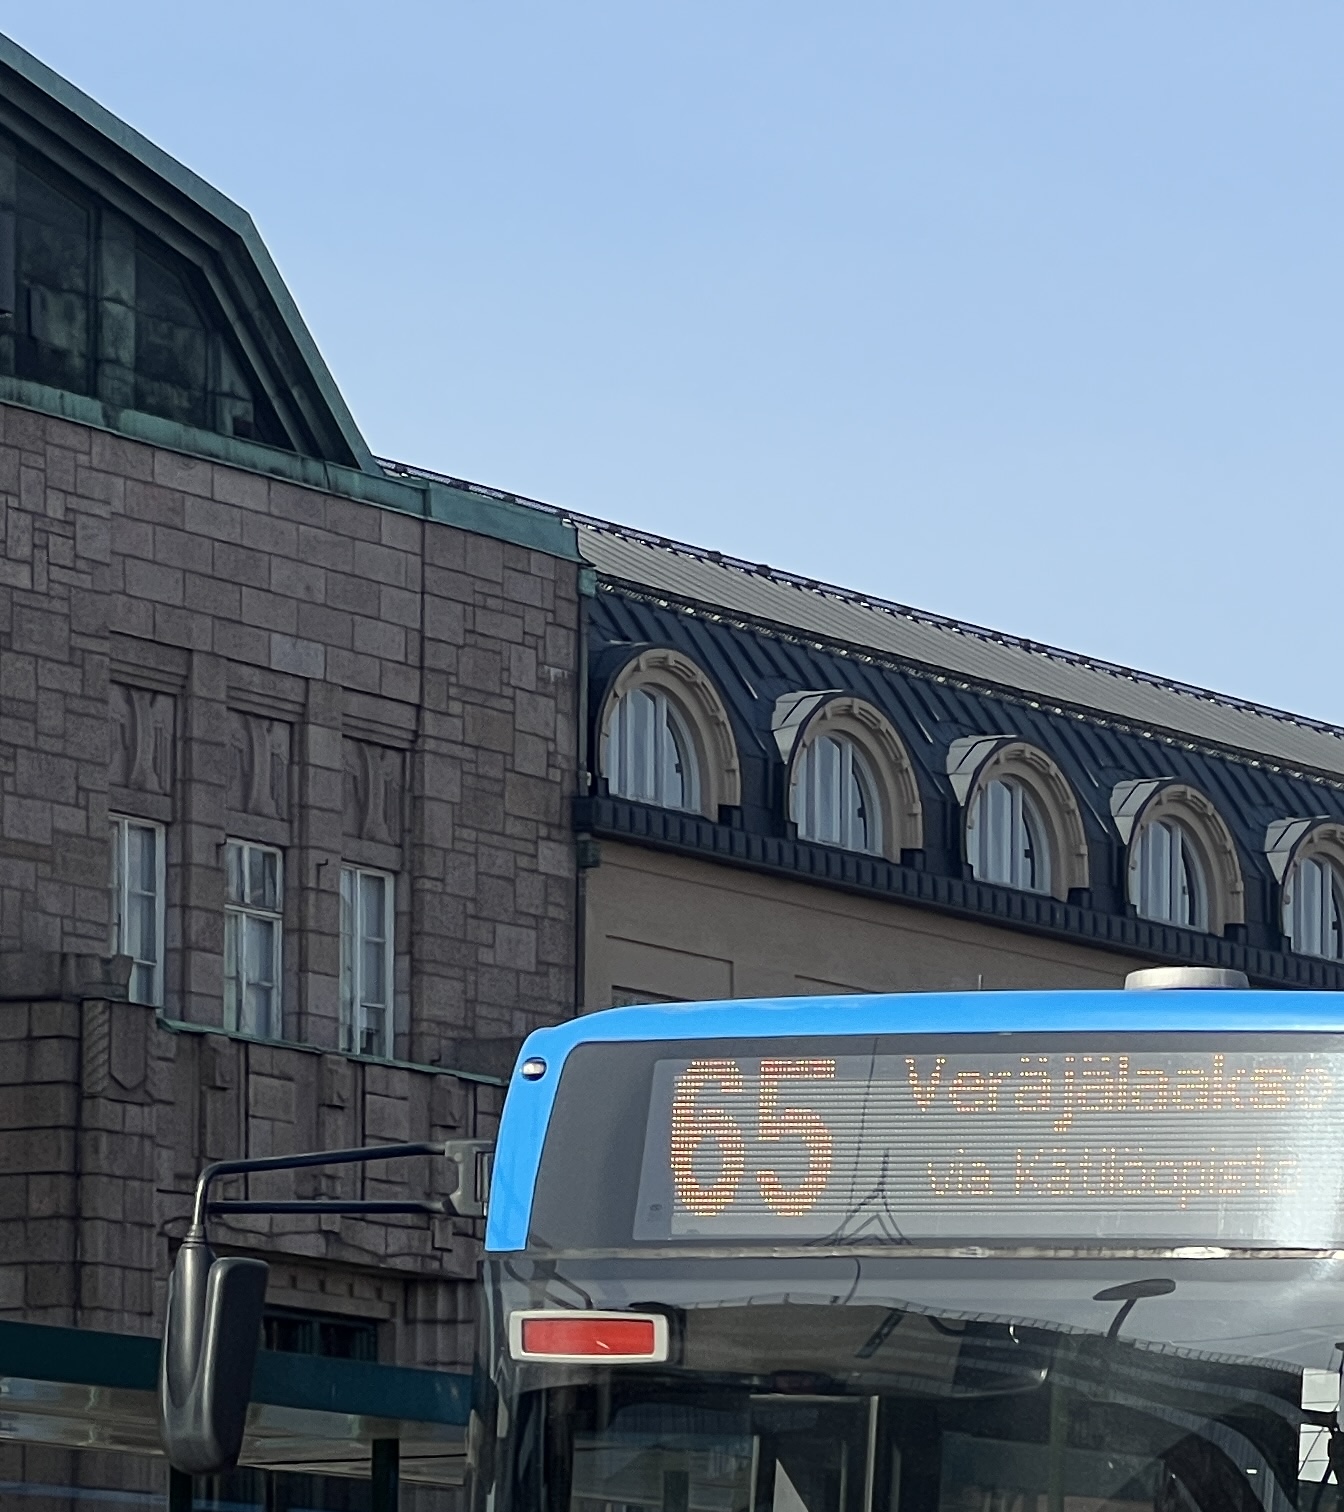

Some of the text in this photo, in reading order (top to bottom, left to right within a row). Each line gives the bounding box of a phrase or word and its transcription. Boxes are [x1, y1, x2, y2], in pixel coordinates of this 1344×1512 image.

[904, 1053, 1334, 1132] Veräjälaakso
[670, 1058, 836, 1217] 65
[926, 1147, 994, 1196] via
